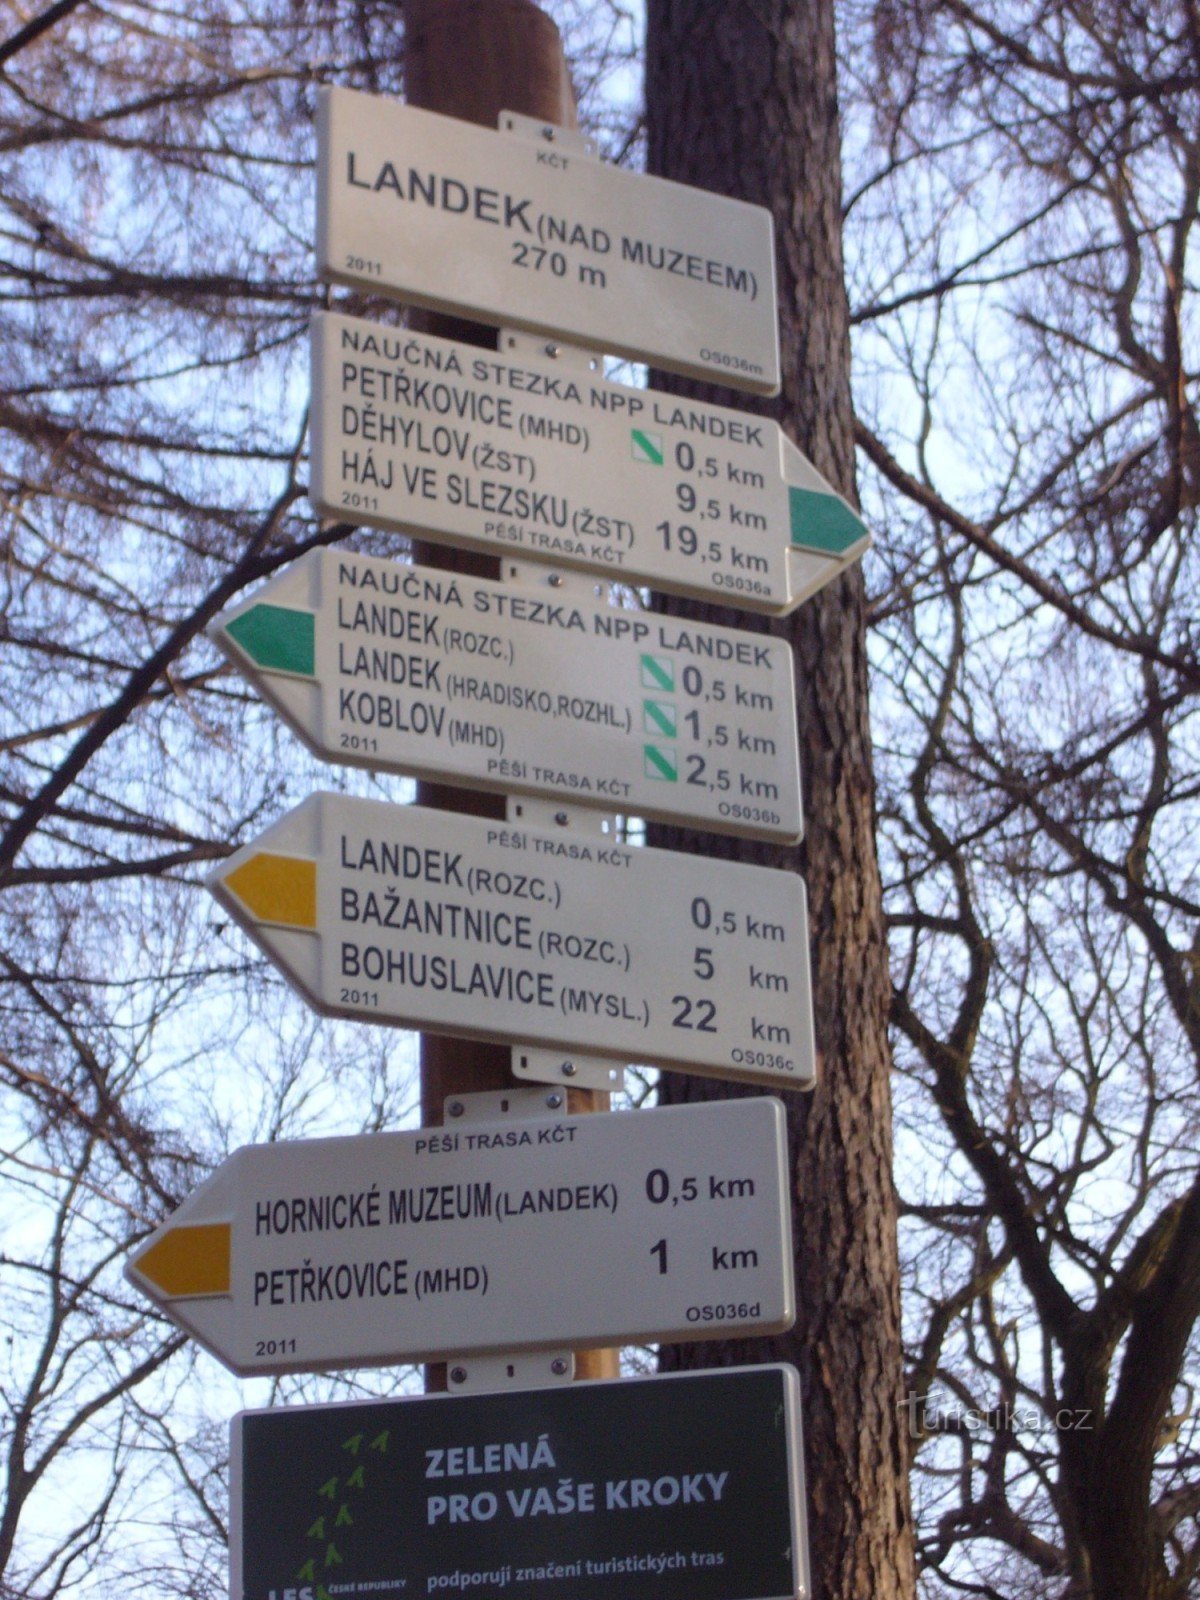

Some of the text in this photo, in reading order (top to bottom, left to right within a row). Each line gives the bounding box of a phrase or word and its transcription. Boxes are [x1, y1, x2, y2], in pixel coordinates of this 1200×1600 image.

[536, 150, 570, 171] KČT
[346, 152, 533, 232] LANDEK
[622, 238, 758, 300] MUZEEM)
[345, 255, 382, 275] 2011
[511, 242, 607, 288] 270 m
[699, 348, 763, 375] OS036m
[341, 329, 764, 448] NAUČNÁ STEZKA NPP LANDEK
[341, 363, 512, 429] PETŘKOVICE
[675, 442, 720, 478] 0,5
[727, 462, 765, 488] km
[341, 405, 469, 461] DĚHYLOV
[676, 483, 721, 521] 9,5
[730, 504, 768, 530] km
[341, 492, 378, 511] 2011
[341, 450, 393, 489] HÁJ
[403, 468, 437, 498] VE
[446, 478, 567, 527] SLEZSKU
[656, 522, 723, 564] 19,5
[730, 547, 769, 573] km
[527, 531, 586, 557] TRASA
[590, 543, 625, 565] KČT
[711, 572, 771, 596] OS036a
[339, 563, 773, 669] NAUČNÁ STEZKA NPP LANDEK
[338, 597, 440, 646] LANDEK
[682, 669, 727, 704] 0,5
[735, 685, 774, 711] km
[339, 643, 441, 692] LANDEK
[683, 710, 729, 749] 1,5
[738, 729, 776, 755] km
[339, 688, 445, 738] KOBLOV
[686, 755, 731, 792] 2,5
[740, 774, 779, 799] km
[340, 735, 378, 752] 2011
[532, 767, 591, 792] TRASA
[596, 778, 631, 797] KČT
[718, 802, 780, 825] OS036b
[534, 837, 593, 861] TRASA
[597, 848, 632, 869] KČT
[340, 835, 463, 888] LANDEK
[691, 897, 736, 935] 0,5
[745, 916, 785, 942] km
[340, 887, 532, 950] BAŽANTNICE
[694, 947, 714, 980] 5
[749, 966, 789, 992] km
[340, 943, 554, 1006] BOHUSLAVICE
[671, 996, 718, 1033] 22
[751, 1018, 791, 1045] km
[340, 988, 378, 1006] 2011
[730, 1048, 794, 1072] OS036c
[464, 1130, 532, 1152] TRASA
[537, 1127, 578, 1145] KČT
[255, 1184, 381, 1236] HORNICKÉ
[388, 1182, 492, 1225] MUZEUM
[645, 1168, 698, 1206] 0,5
[709, 1175, 754, 1199] km
[254, 1259, 408, 1306] PETŘKOVICE
[649, 1239, 669, 1275] 1
[712, 1247, 758, 1270] km
[685, 1303, 761, 1323] OS036d
[255, 1339, 297, 1357] 2011
[425, 1433, 556, 1478] ZELENÁ
[426, 1472, 729, 1524] PRO VAŠE KROKY
[426, 1550, 724, 1593] podporují značení turistických tras
